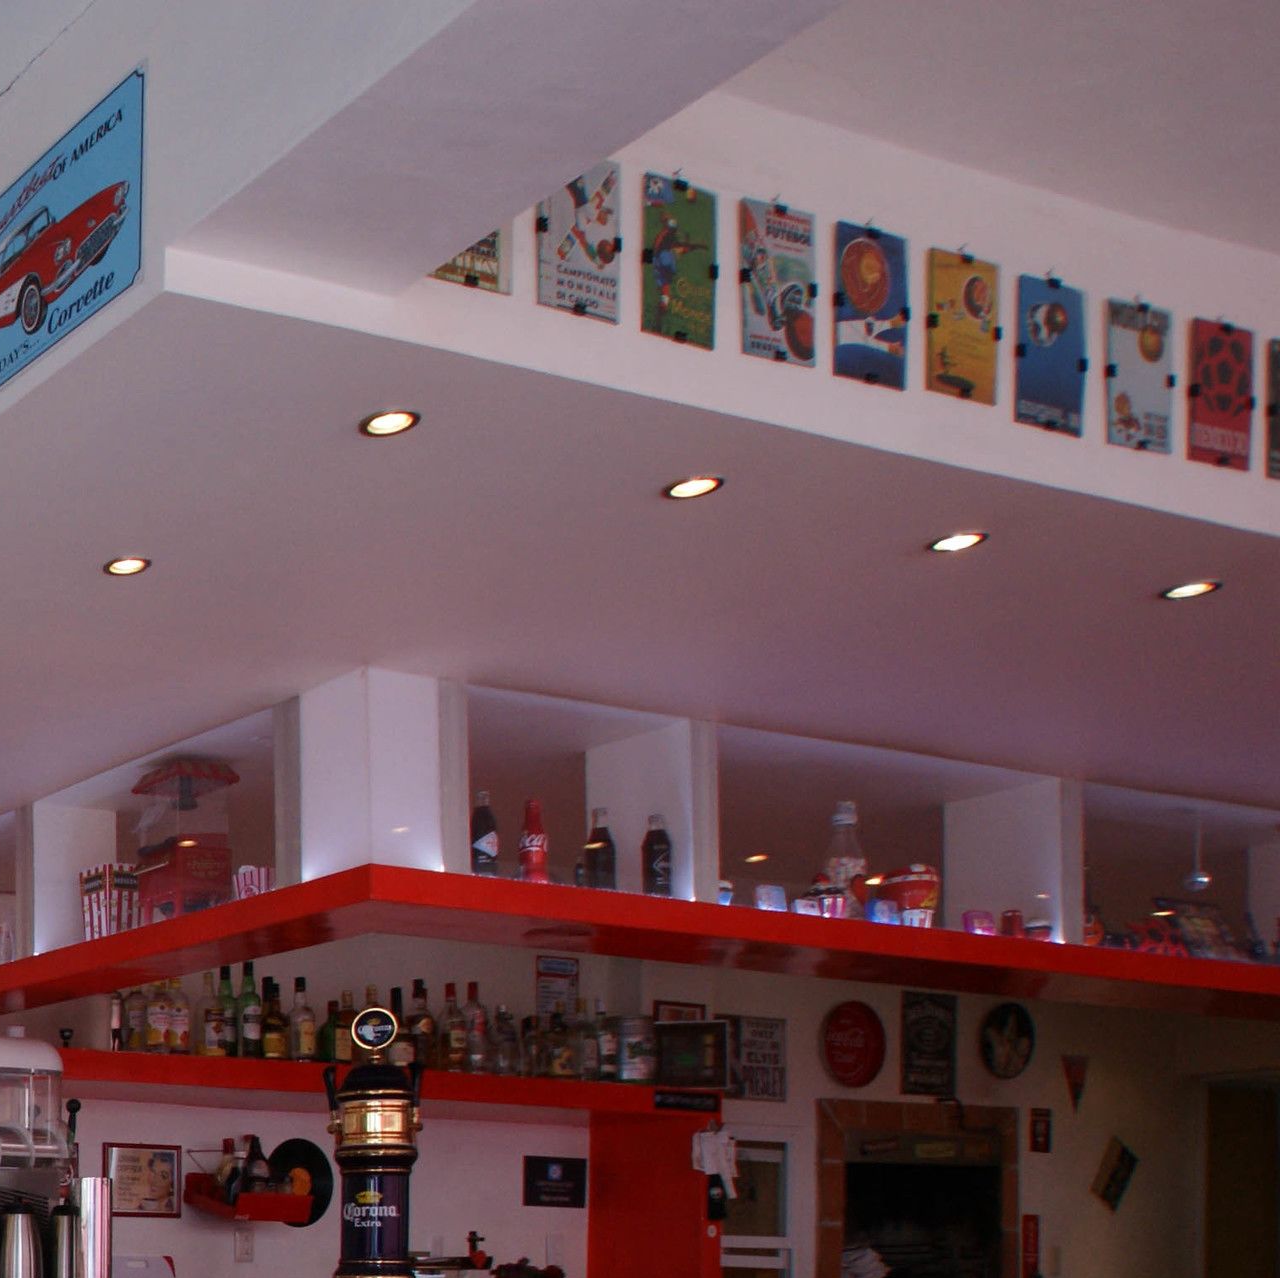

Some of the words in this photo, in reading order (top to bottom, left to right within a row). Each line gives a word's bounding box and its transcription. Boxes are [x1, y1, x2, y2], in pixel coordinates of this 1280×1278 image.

[70, 108, 123, 166] AMERICA
[557, 264, 617, 288] CAMPIONATO
[557, 278, 617, 302] MONDIALE
[47, 272, 115, 334] Corvette
[344, 1202, 400, 1223] Corona
[354, 1218, 383, 1229] Extra
